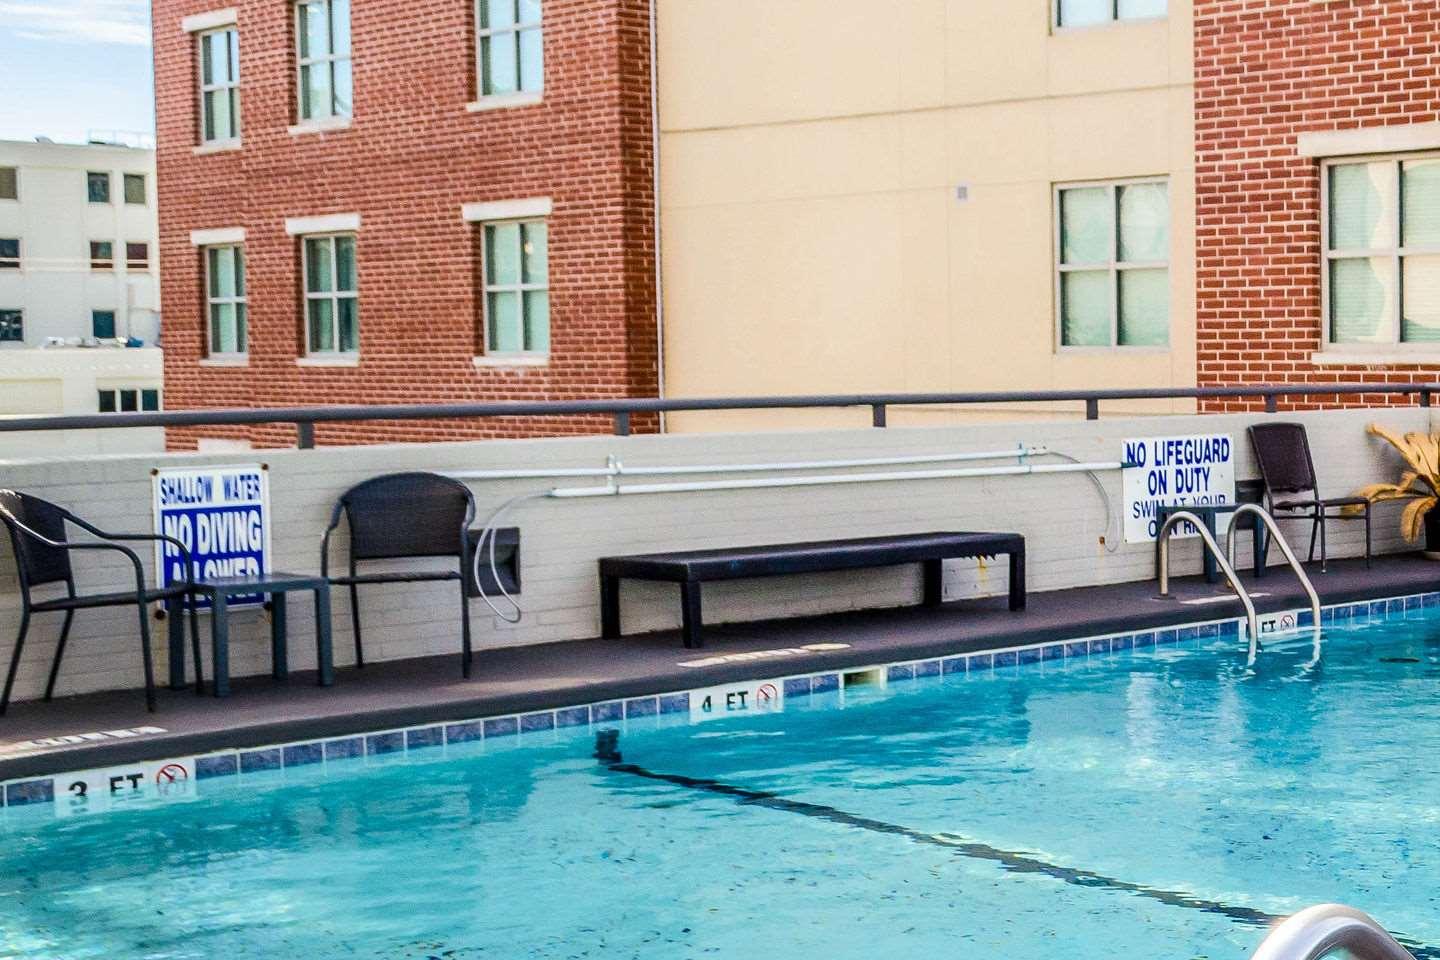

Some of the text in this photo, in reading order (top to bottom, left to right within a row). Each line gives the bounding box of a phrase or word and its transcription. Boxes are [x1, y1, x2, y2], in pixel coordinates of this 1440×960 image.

[1126, 438, 1230, 468] NO LIFEGUARD
[161, 474, 260, 505] SHALLOW WATER
[1148, 466, 1210, 496] ON DUTY
[164, 509, 262, 557] NO DIVING
